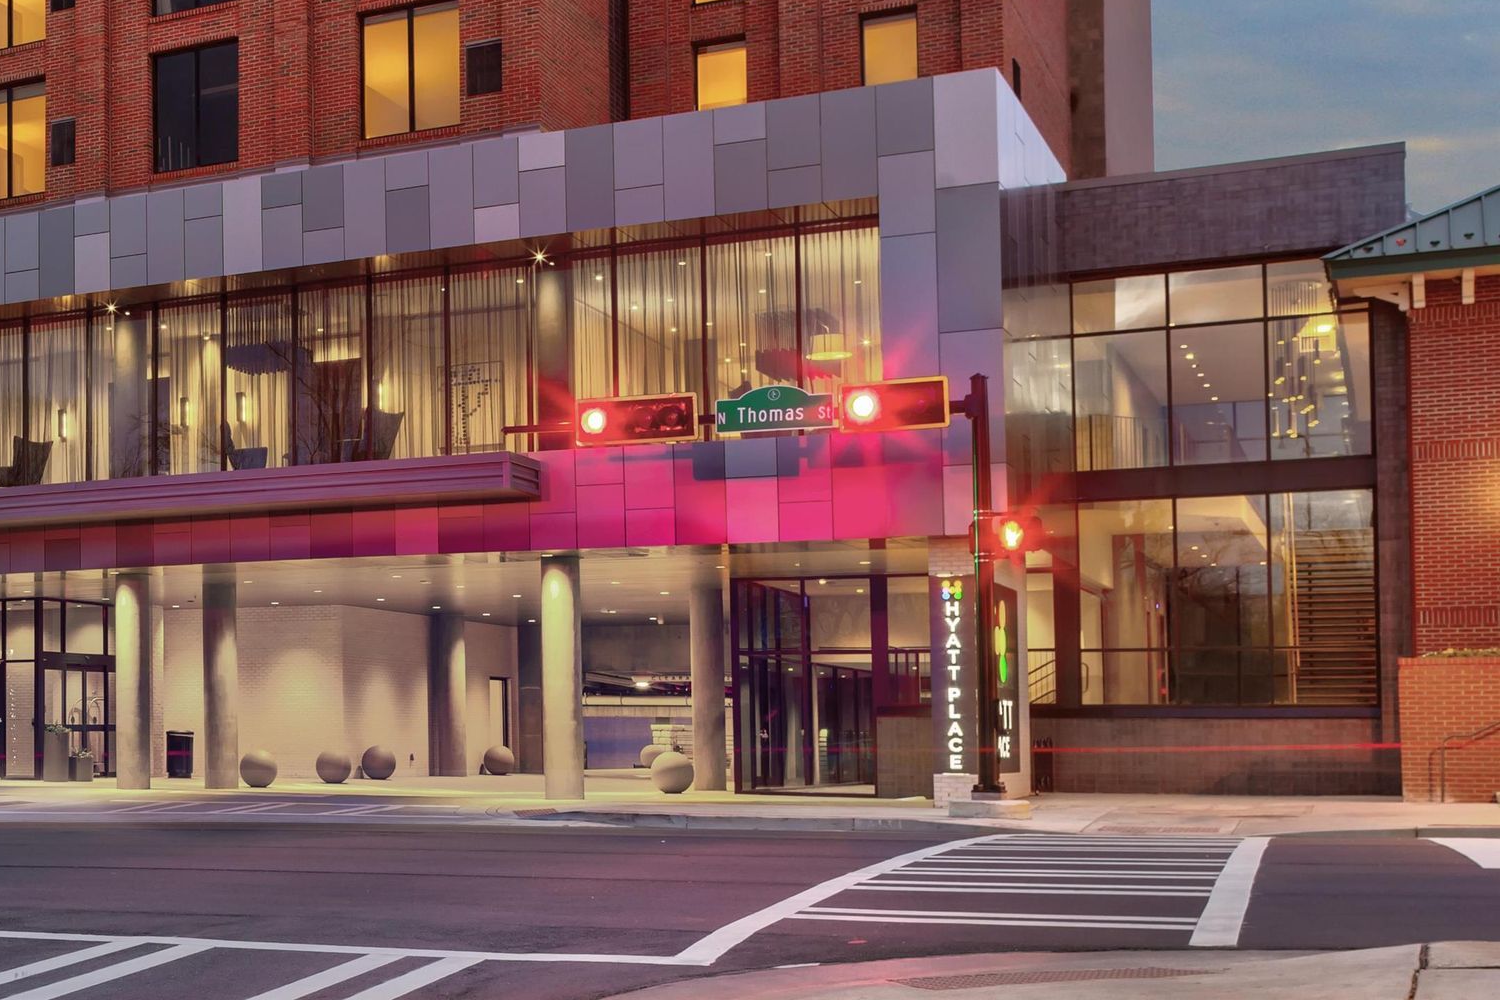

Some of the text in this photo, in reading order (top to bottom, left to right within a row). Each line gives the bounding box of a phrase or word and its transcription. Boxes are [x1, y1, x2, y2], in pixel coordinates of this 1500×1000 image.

[718, 406, 831, 425] N Thomas St
[945, 601, 964, 770] HYATT PLACE
